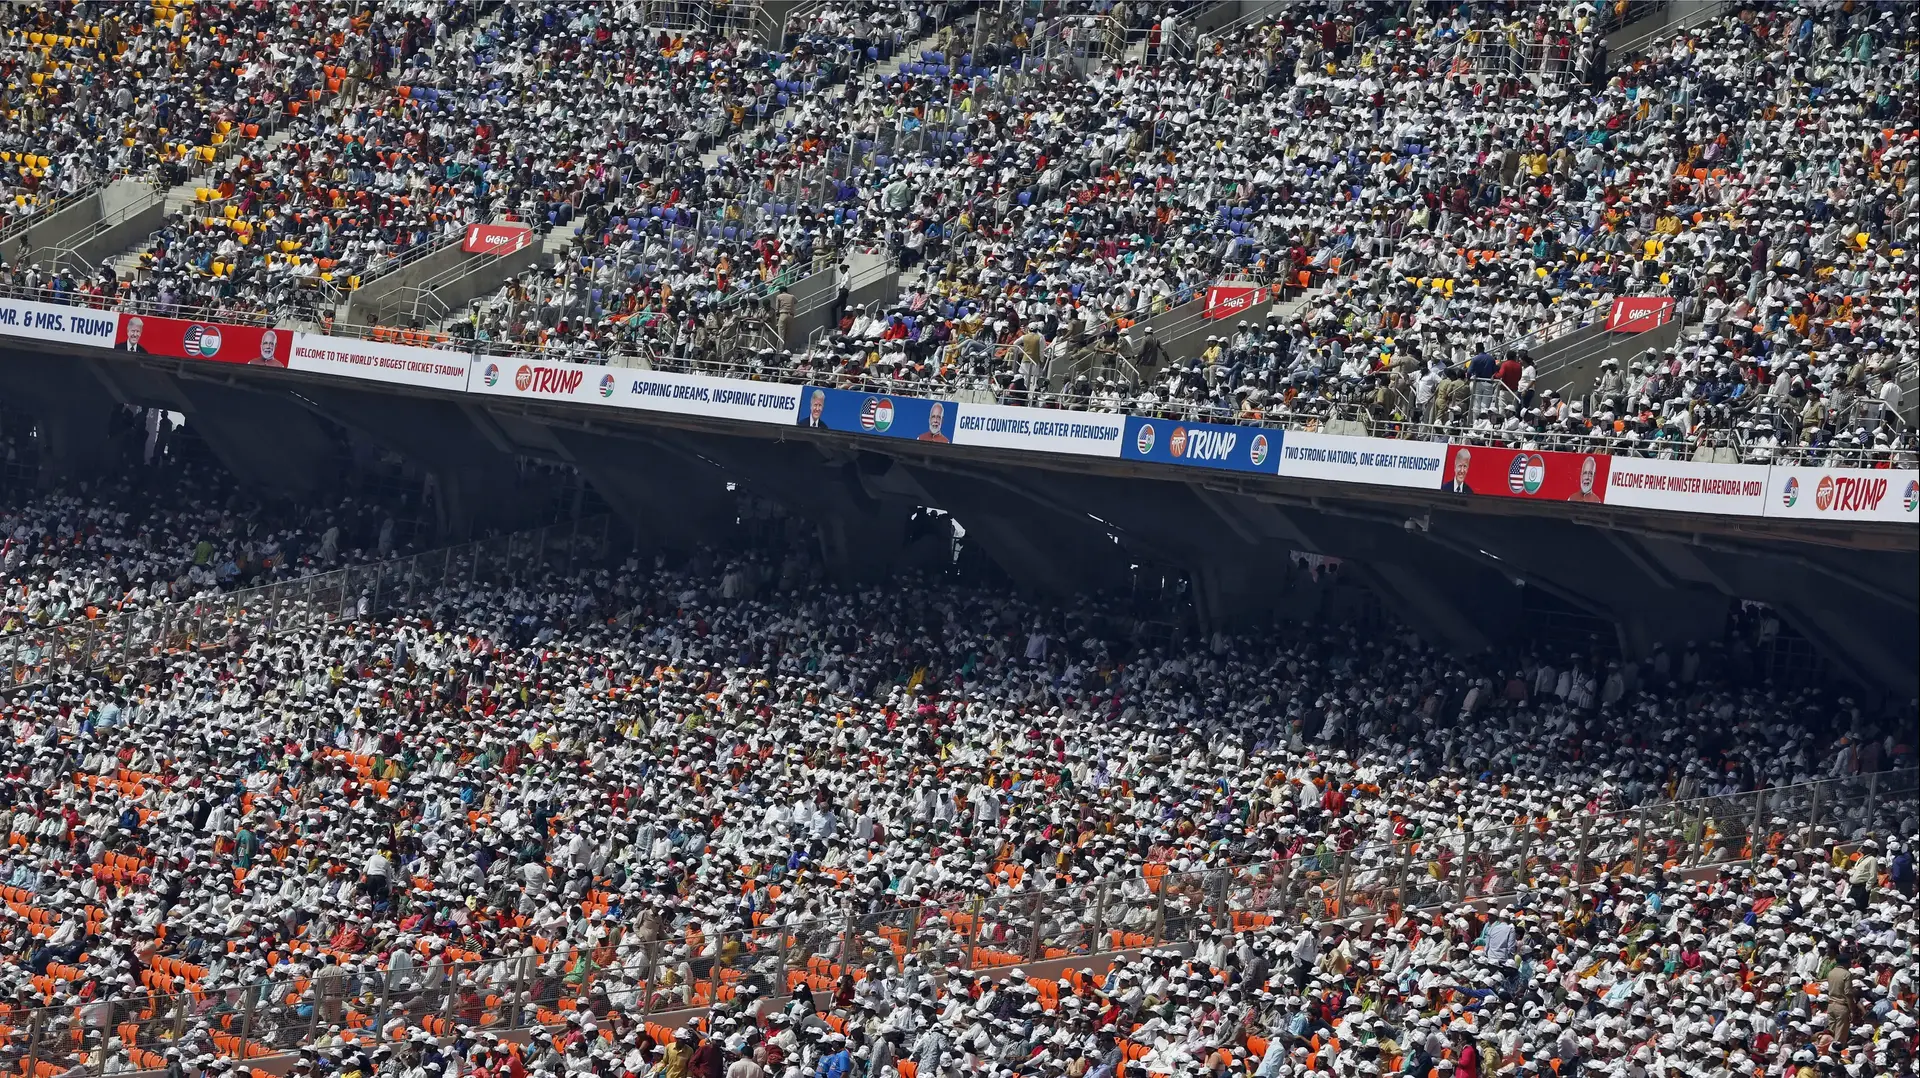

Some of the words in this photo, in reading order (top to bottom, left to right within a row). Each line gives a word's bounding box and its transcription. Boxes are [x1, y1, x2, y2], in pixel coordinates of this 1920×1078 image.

[0, 307, 19, 326] MR.
[23, 310, 32, 327] &
[35, 311, 65, 332] MRS.
[70, 316, 113, 337] TRUMP
[295, 346, 325, 360] WELCOME
[327, 350, 335, 361] TO
[336, 351, 348, 362] THE
[349, 353, 378, 366] WORLD'S
[379, 357, 406, 370] BIGGEST
[407, 360, 433, 373] CRICKET
[433, 364, 464, 377] STADIUM
[532, 367, 583, 394] TRUMP
[631, 380, 671, 398] ASPIRING
[672, 384, 709, 404] DREAMS,
[711, 388, 756, 406] INSPIRING
[757, 393, 795, 411] FUTURES
[959, 415, 985, 431] GREAT
[985, 417, 1030, 436] COUNTRIES,
[1032, 420, 1069, 437] GREATER
[1069, 423, 1118, 441] FRIENDSHIP
[1186, 429, 1237, 460] TRUMP
[1284, 446, 1298, 460] TWO
[1298, 447, 1326, 462] STRONG
[1326, 449, 1358, 466] NATIONS,
[1359, 452, 1374, 466] ONE
[1374, 453, 1397, 468] GREAT
[1397, 455, 1439, 471] FRIENDSHIP
[1611, 470, 1643, 488] WELCOME
[1643, 474, 1666, 490] PRIME
[1666, 476, 1701, 493] MINISTER
[1701, 478, 1741, 496] NARENDRA
[1741, 481, 1762, 497] MODI
[1833, 477, 1888, 511] TRUMP
